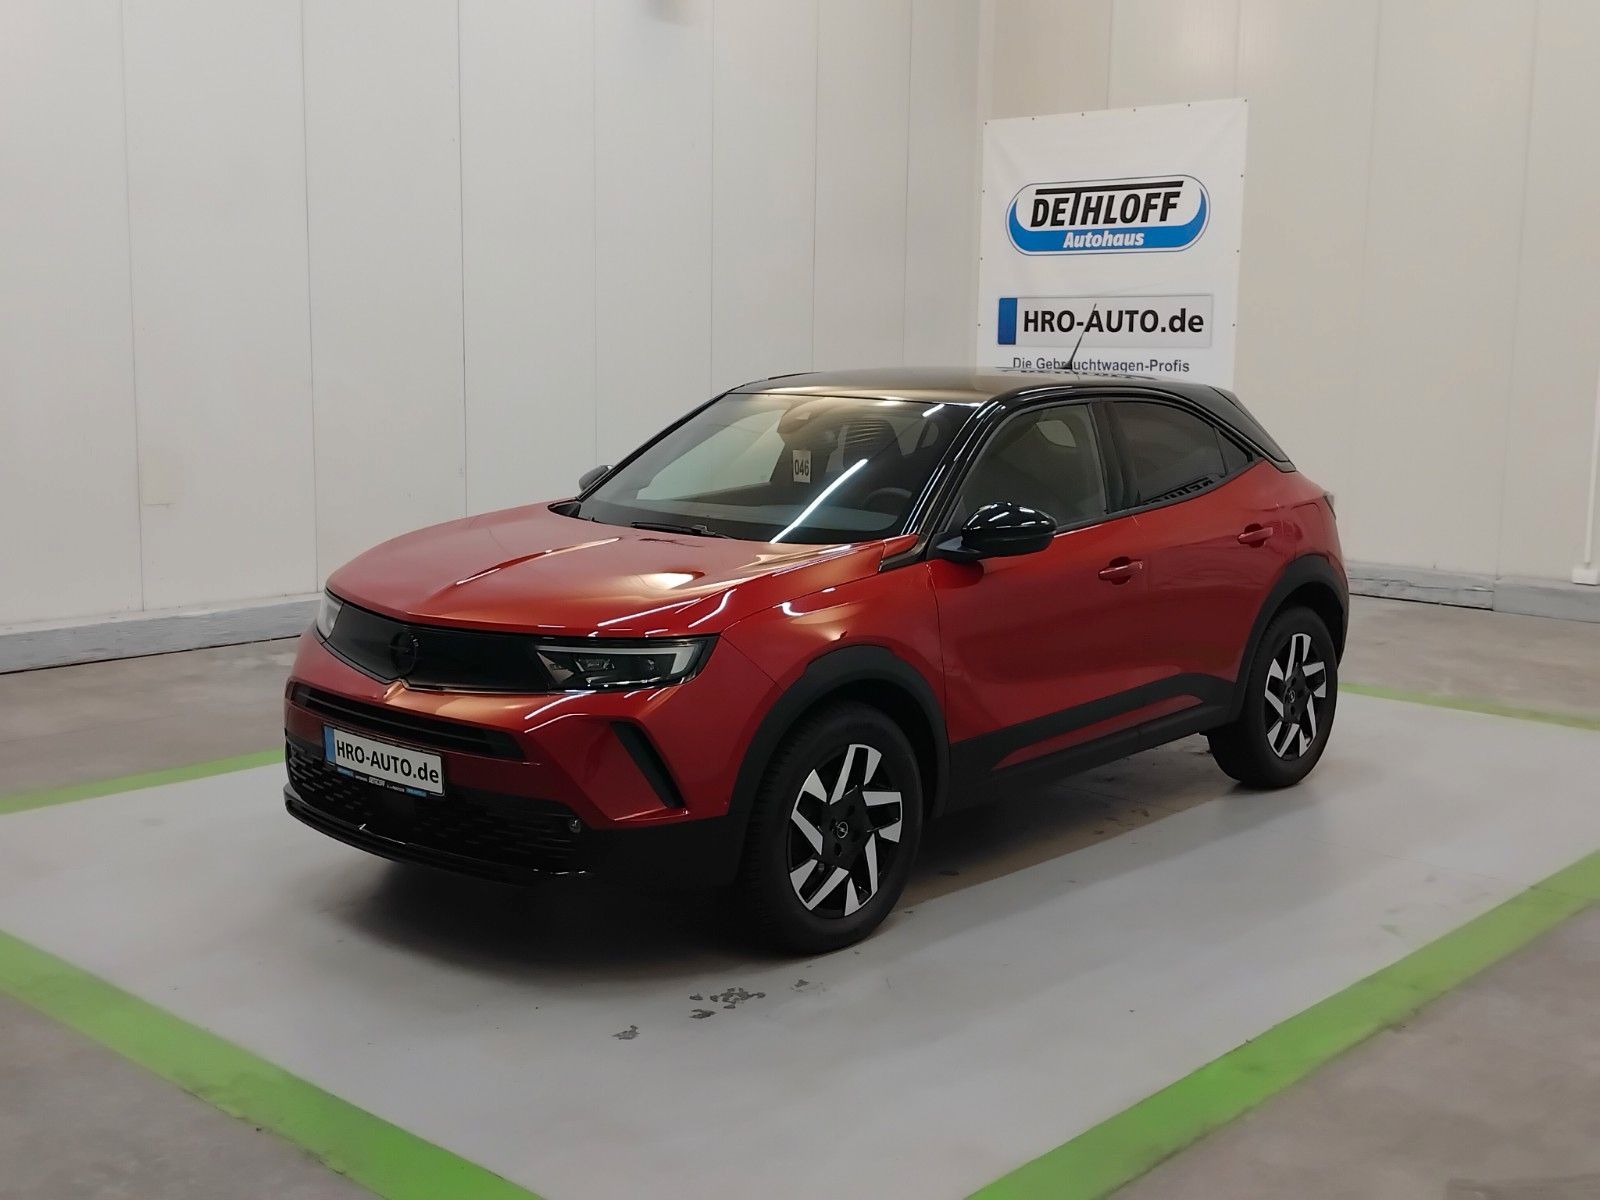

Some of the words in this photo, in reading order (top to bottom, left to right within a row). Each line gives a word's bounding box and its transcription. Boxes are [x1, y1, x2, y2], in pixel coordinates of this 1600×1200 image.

[1030, 181, 1184, 227] DETHLOFF
[1063, 231, 1144, 249] Autohaus
[1023, 308, 1204, 333] HRO-AUTO.de
[1013, 357, 1032, 369] Die
[1036, 357, 1190, 373] Gebruchtwagen-Profis
[794, 459, 810, 477] 046
[336, 739, 440, 783] HRO-AUTO.de
